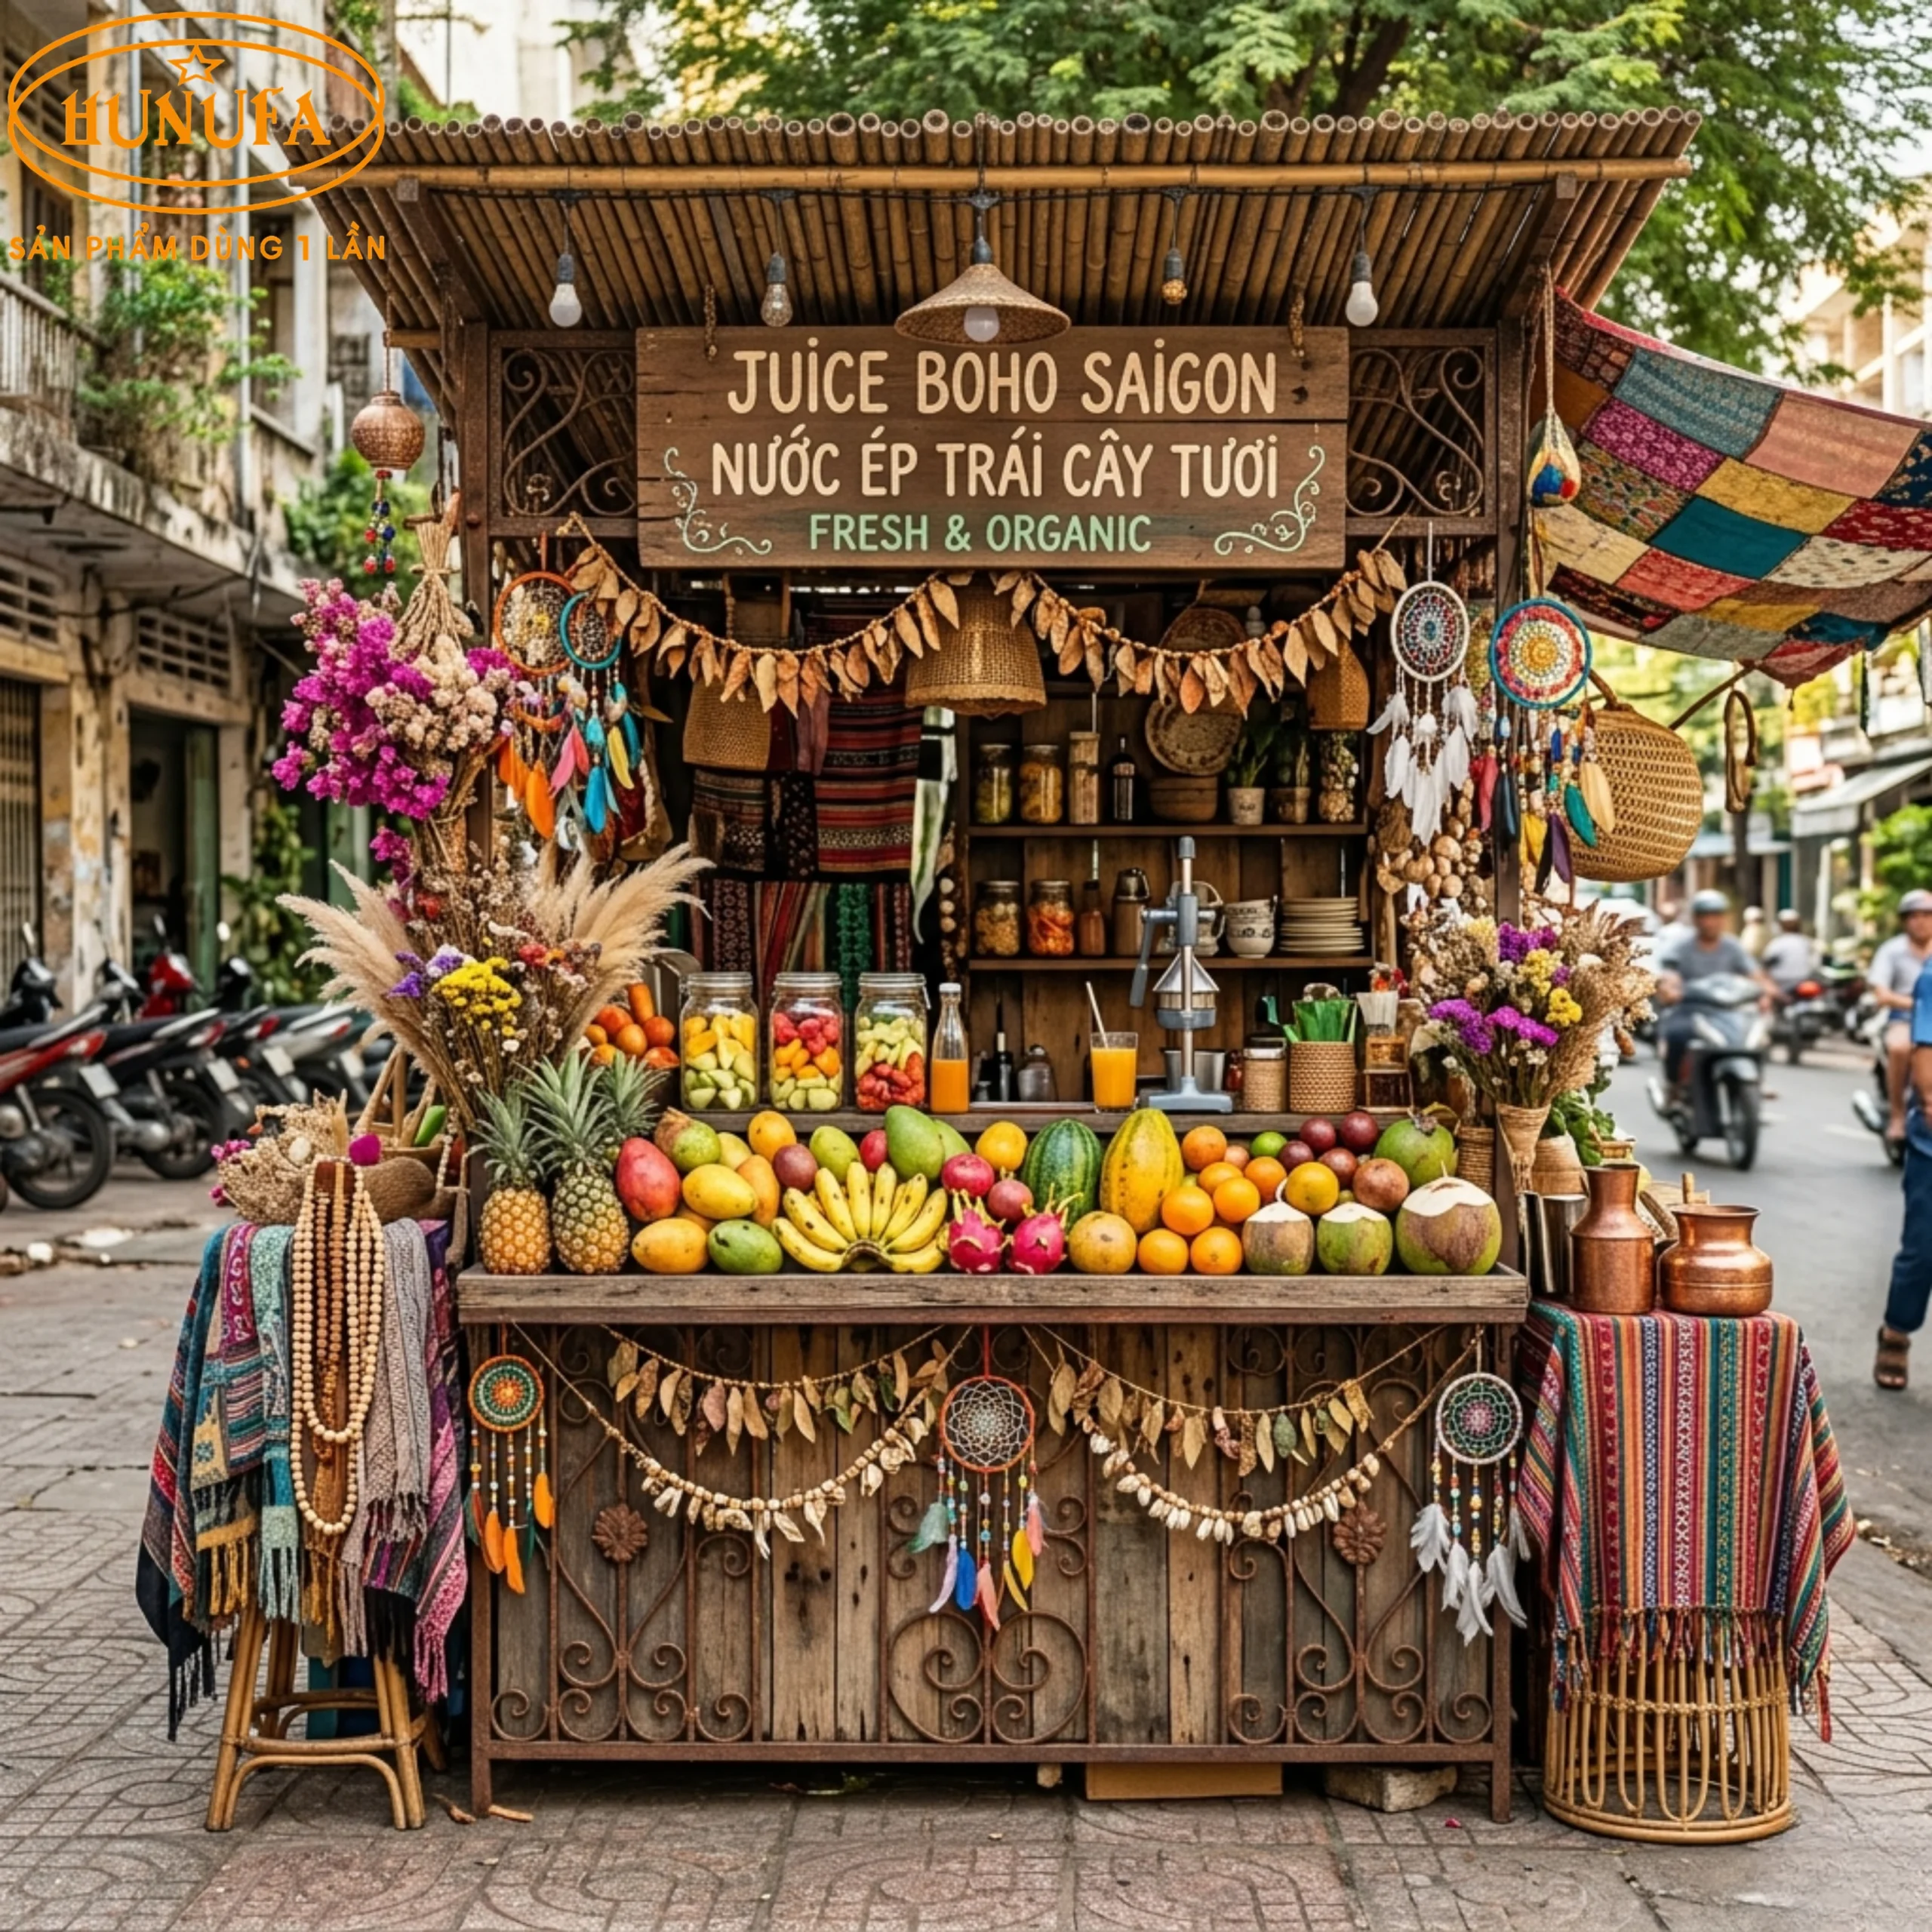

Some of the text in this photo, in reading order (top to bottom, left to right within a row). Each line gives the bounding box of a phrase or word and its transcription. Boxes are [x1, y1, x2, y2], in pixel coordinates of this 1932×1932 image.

[916, 350, 1057, 414] BOHO
[712, 423, 841, 497] NƯỚC
[861, 426, 918, 497] ÉP
[1063, 428, 1154, 498] CÂY
[810, 514, 1152, 553] FRESH & ORGANIC
